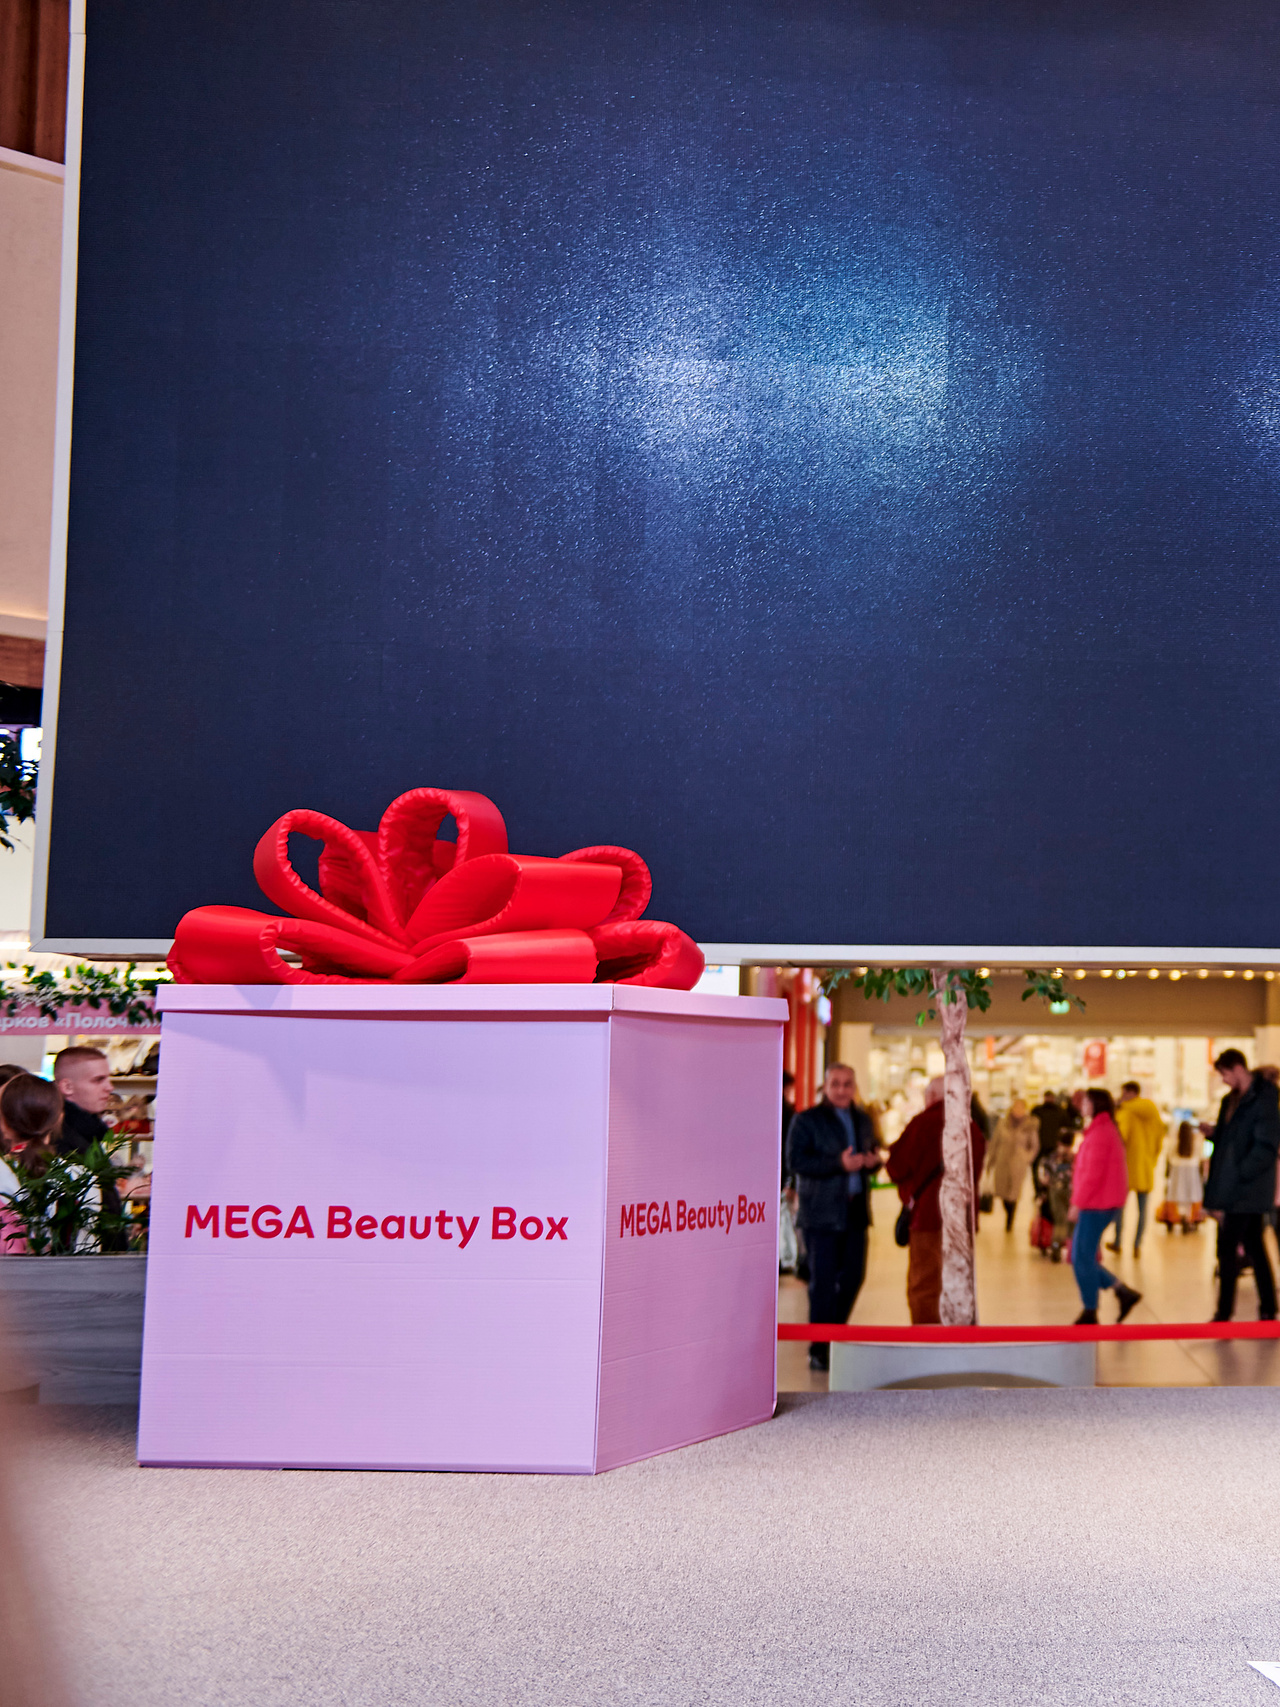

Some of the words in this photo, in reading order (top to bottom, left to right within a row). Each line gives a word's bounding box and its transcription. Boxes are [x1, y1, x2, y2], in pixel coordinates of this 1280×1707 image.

[184, 1204, 315, 1239] MEGA
[326, 1205, 481, 1250] Beauty
[491, 1206, 569, 1241] Box
[619, 1200, 673, 1239] MEGA
[676, 1199, 735, 1235] Beauty
[737, 1194, 767, 1226] Box
